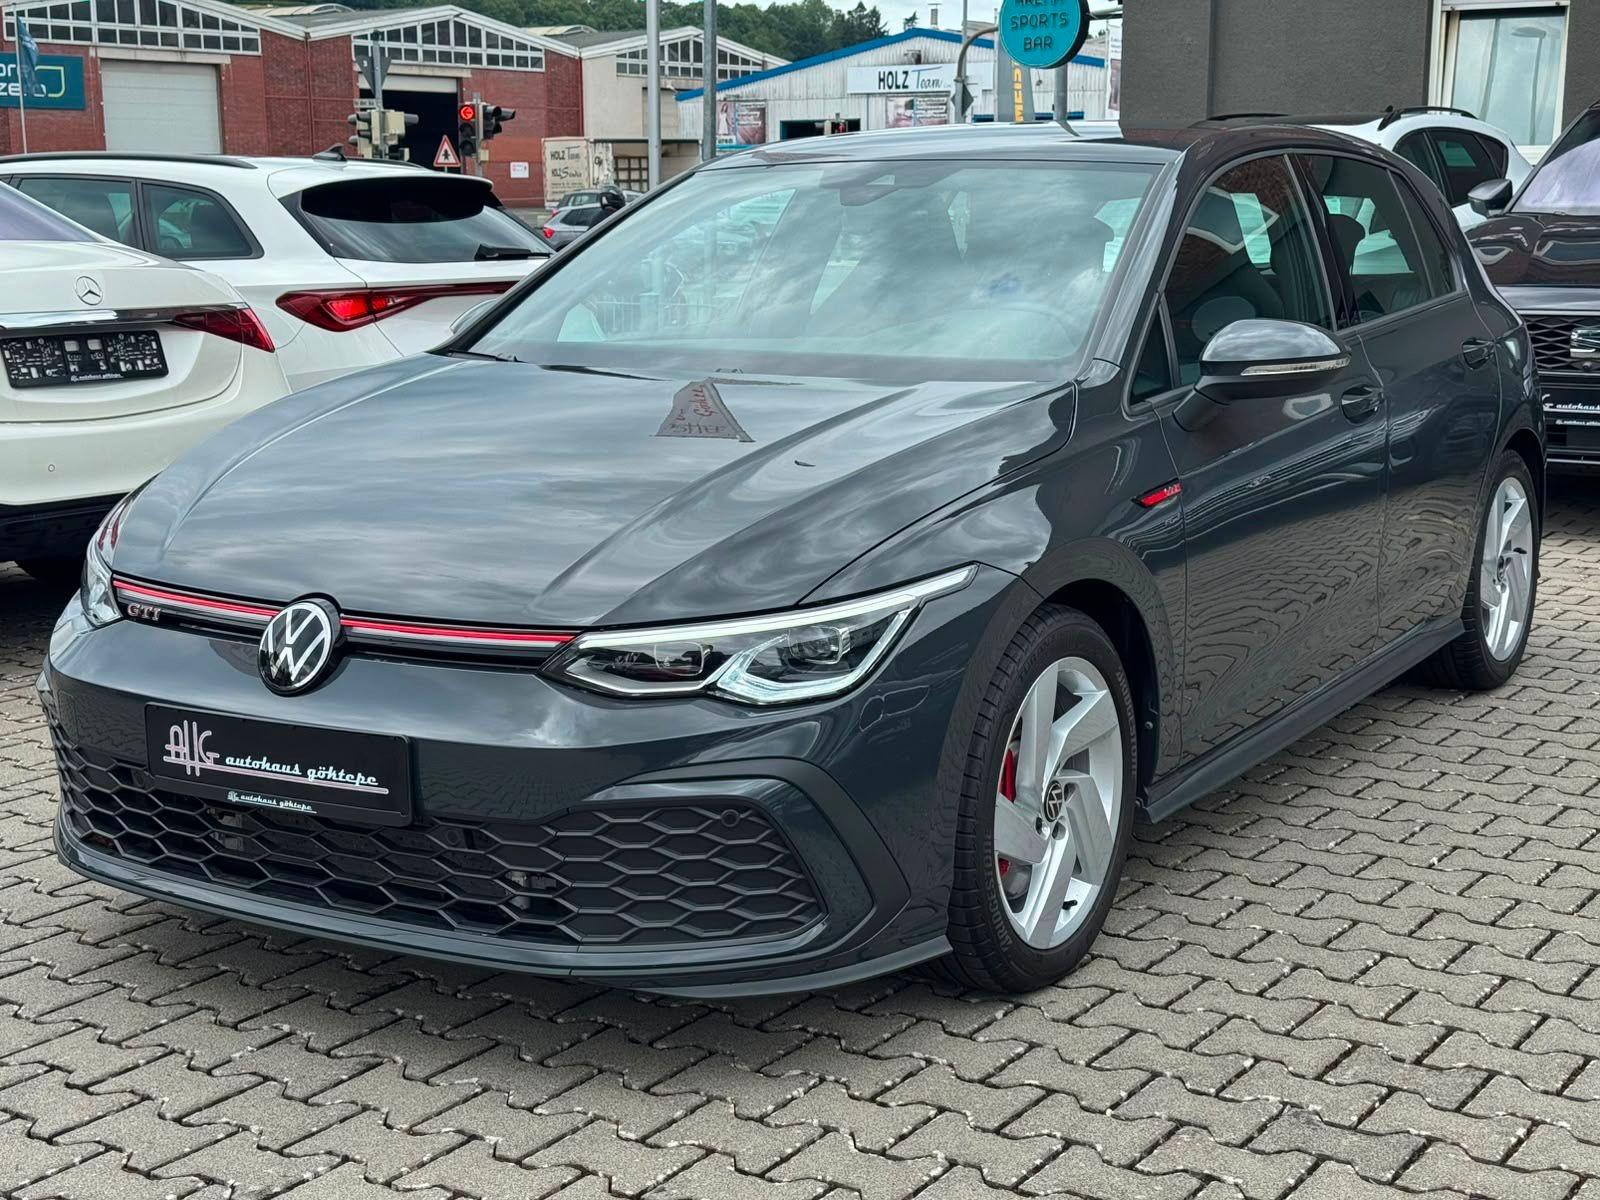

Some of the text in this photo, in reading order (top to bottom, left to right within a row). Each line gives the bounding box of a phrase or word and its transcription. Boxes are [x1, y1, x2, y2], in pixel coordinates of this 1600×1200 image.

[1010, 12, 1069, 30] SPORTS
[1023, 36, 1053, 52] BAR
[878, 66, 943, 90] HOLZ Team
[127, 602, 161, 621] GTI
[225, 756, 302, 776] autohaus
[306, 766, 379, 787] göktepe
[240, 794, 277, 805] autohaus
[279, 800, 312, 811] göktepe
